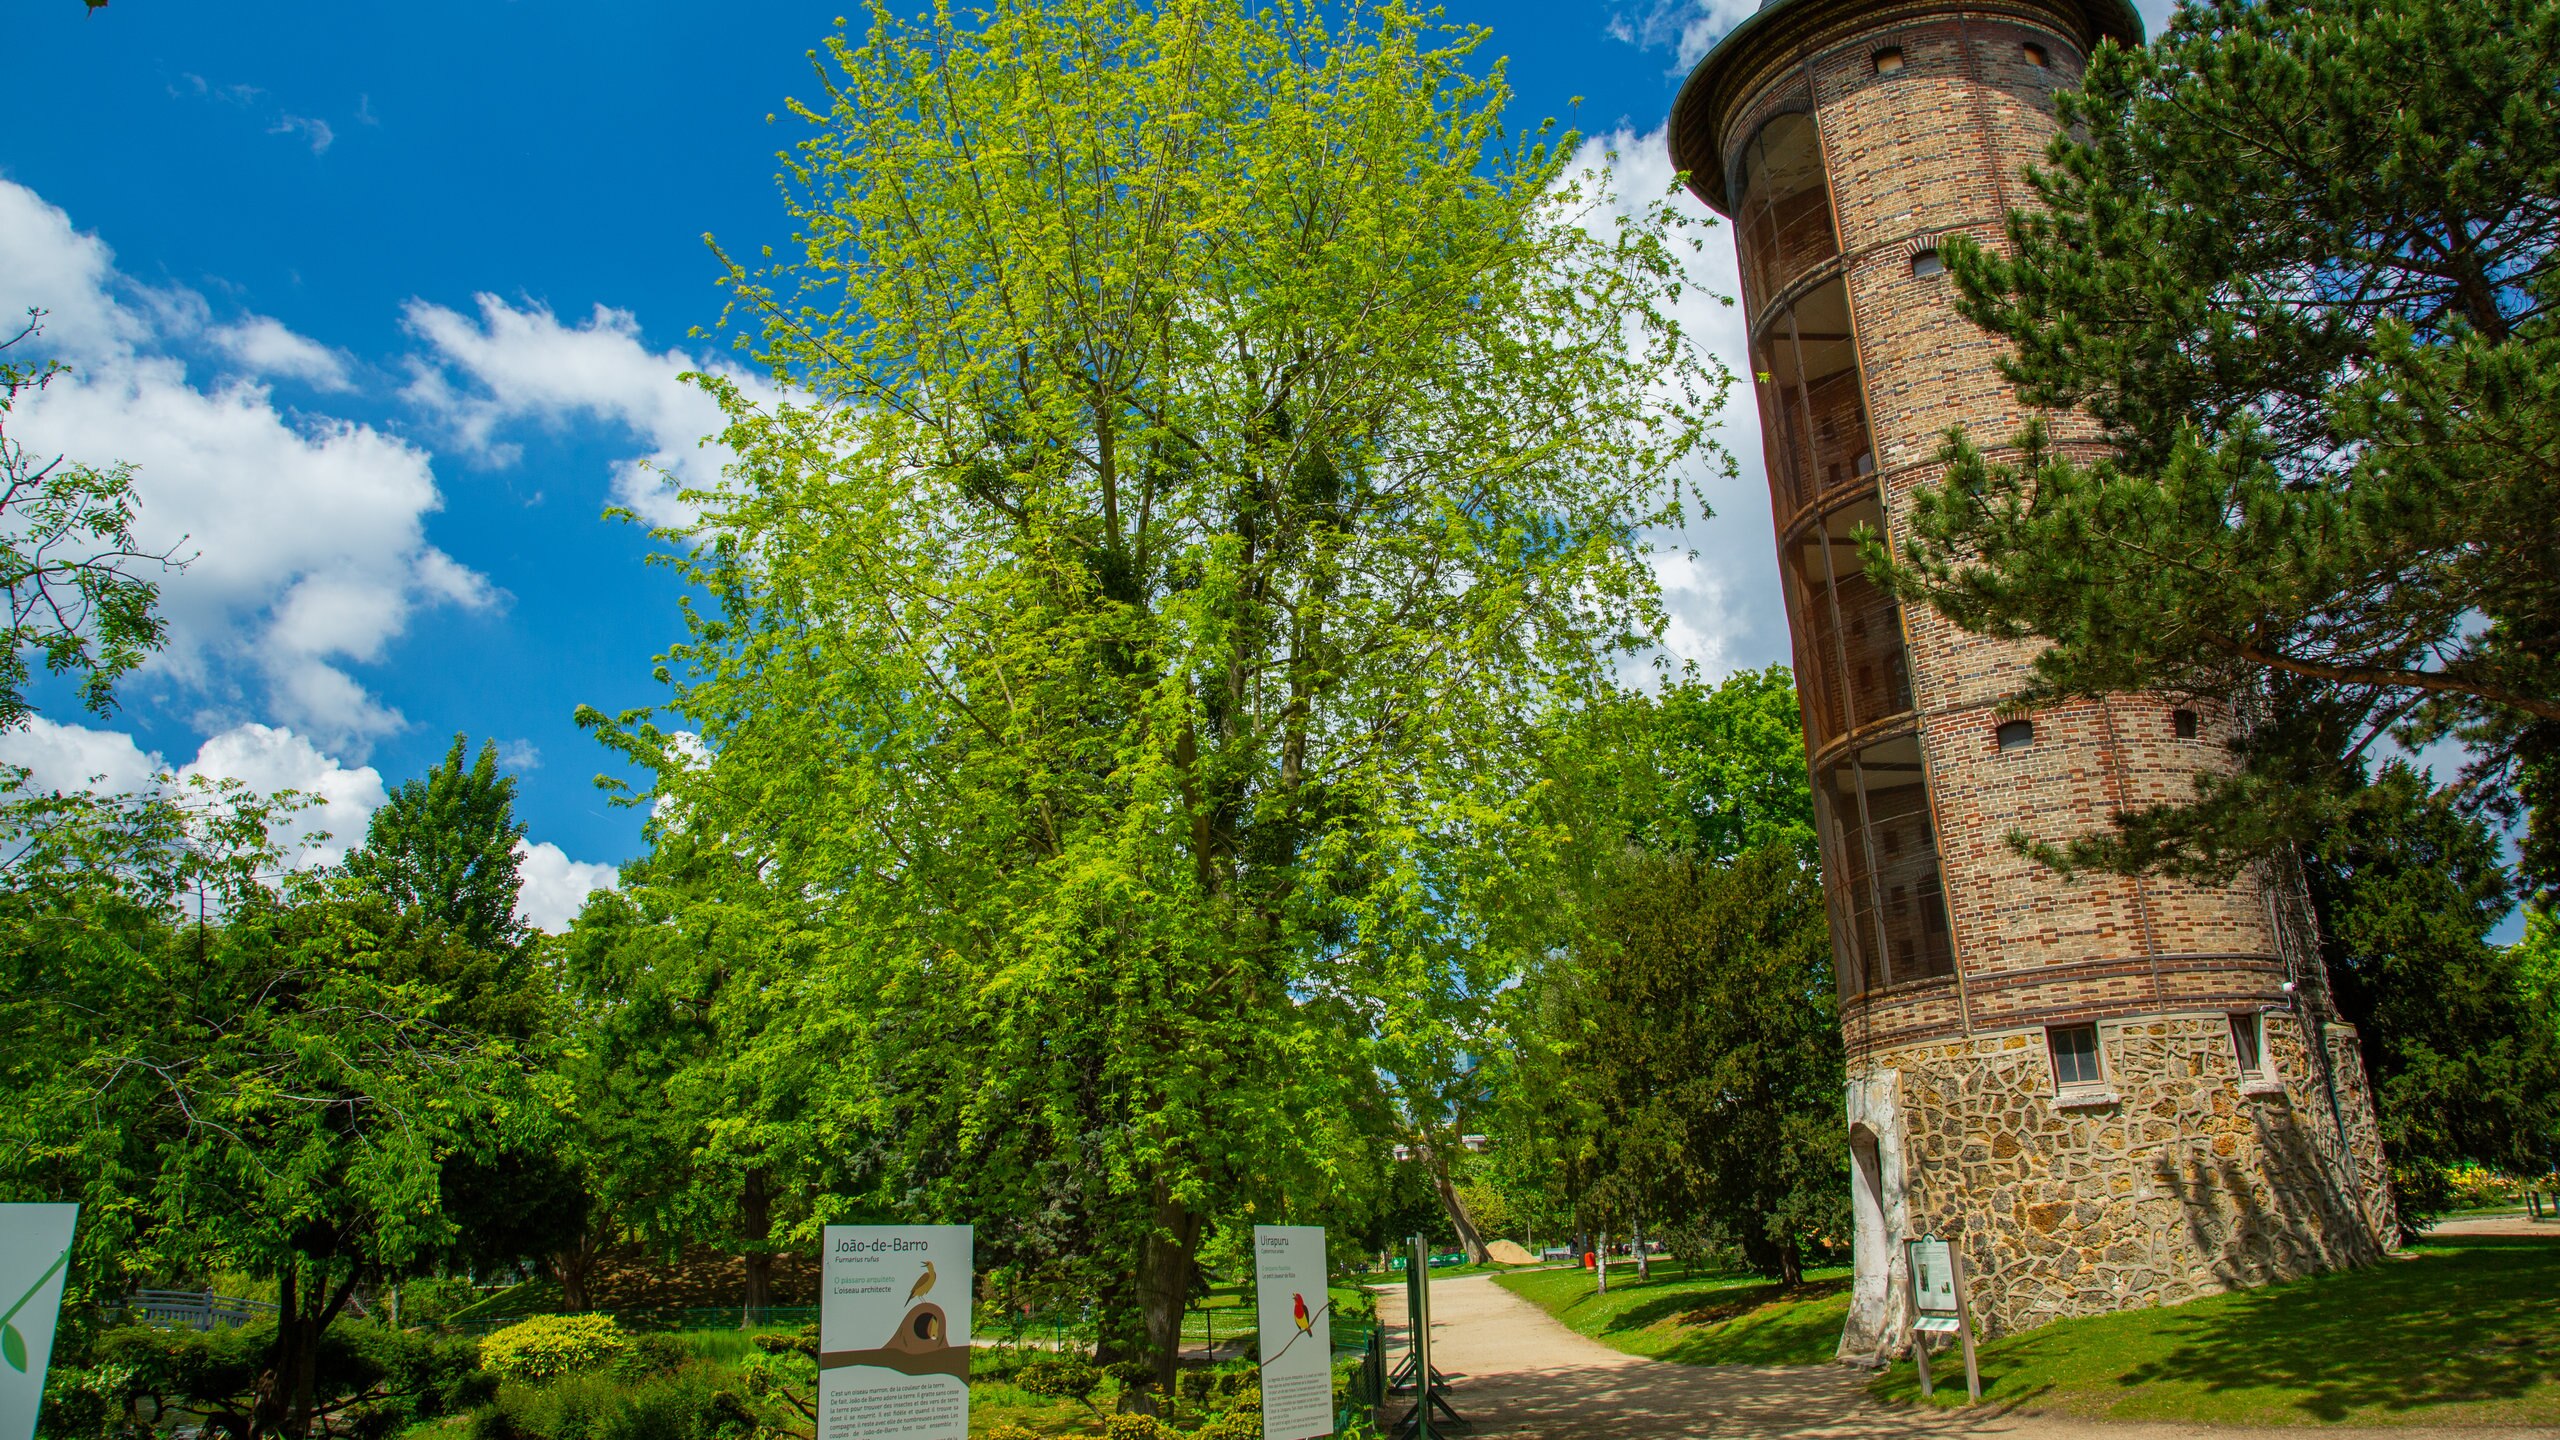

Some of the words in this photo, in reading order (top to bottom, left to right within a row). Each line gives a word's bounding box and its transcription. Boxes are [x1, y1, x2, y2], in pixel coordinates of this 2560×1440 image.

[835, 1238, 928, 1252] João-de-Barro
[1261, 1235, 1289, 1248] Uirapuru
[867, 1276, 895, 1284] arquiteto
